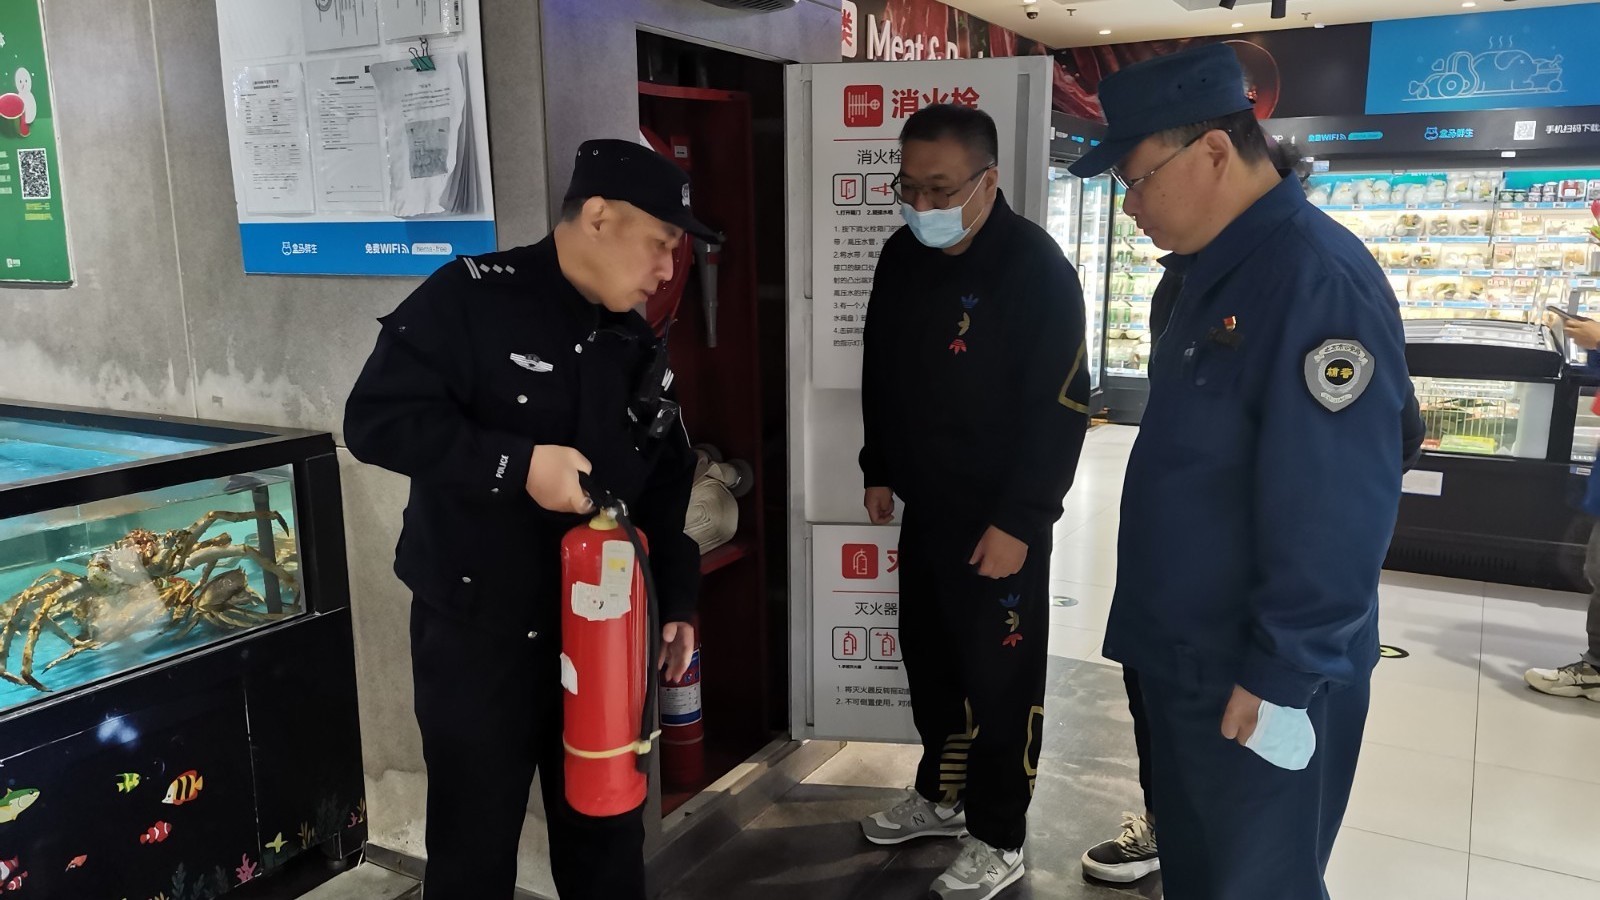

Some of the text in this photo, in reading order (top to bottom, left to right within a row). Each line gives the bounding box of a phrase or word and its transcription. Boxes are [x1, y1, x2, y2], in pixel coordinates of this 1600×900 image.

[867, 13, 924, 61] Meat
[495, 454, 509, 478] POLICE
[854, 602, 899, 616] 灭火器
